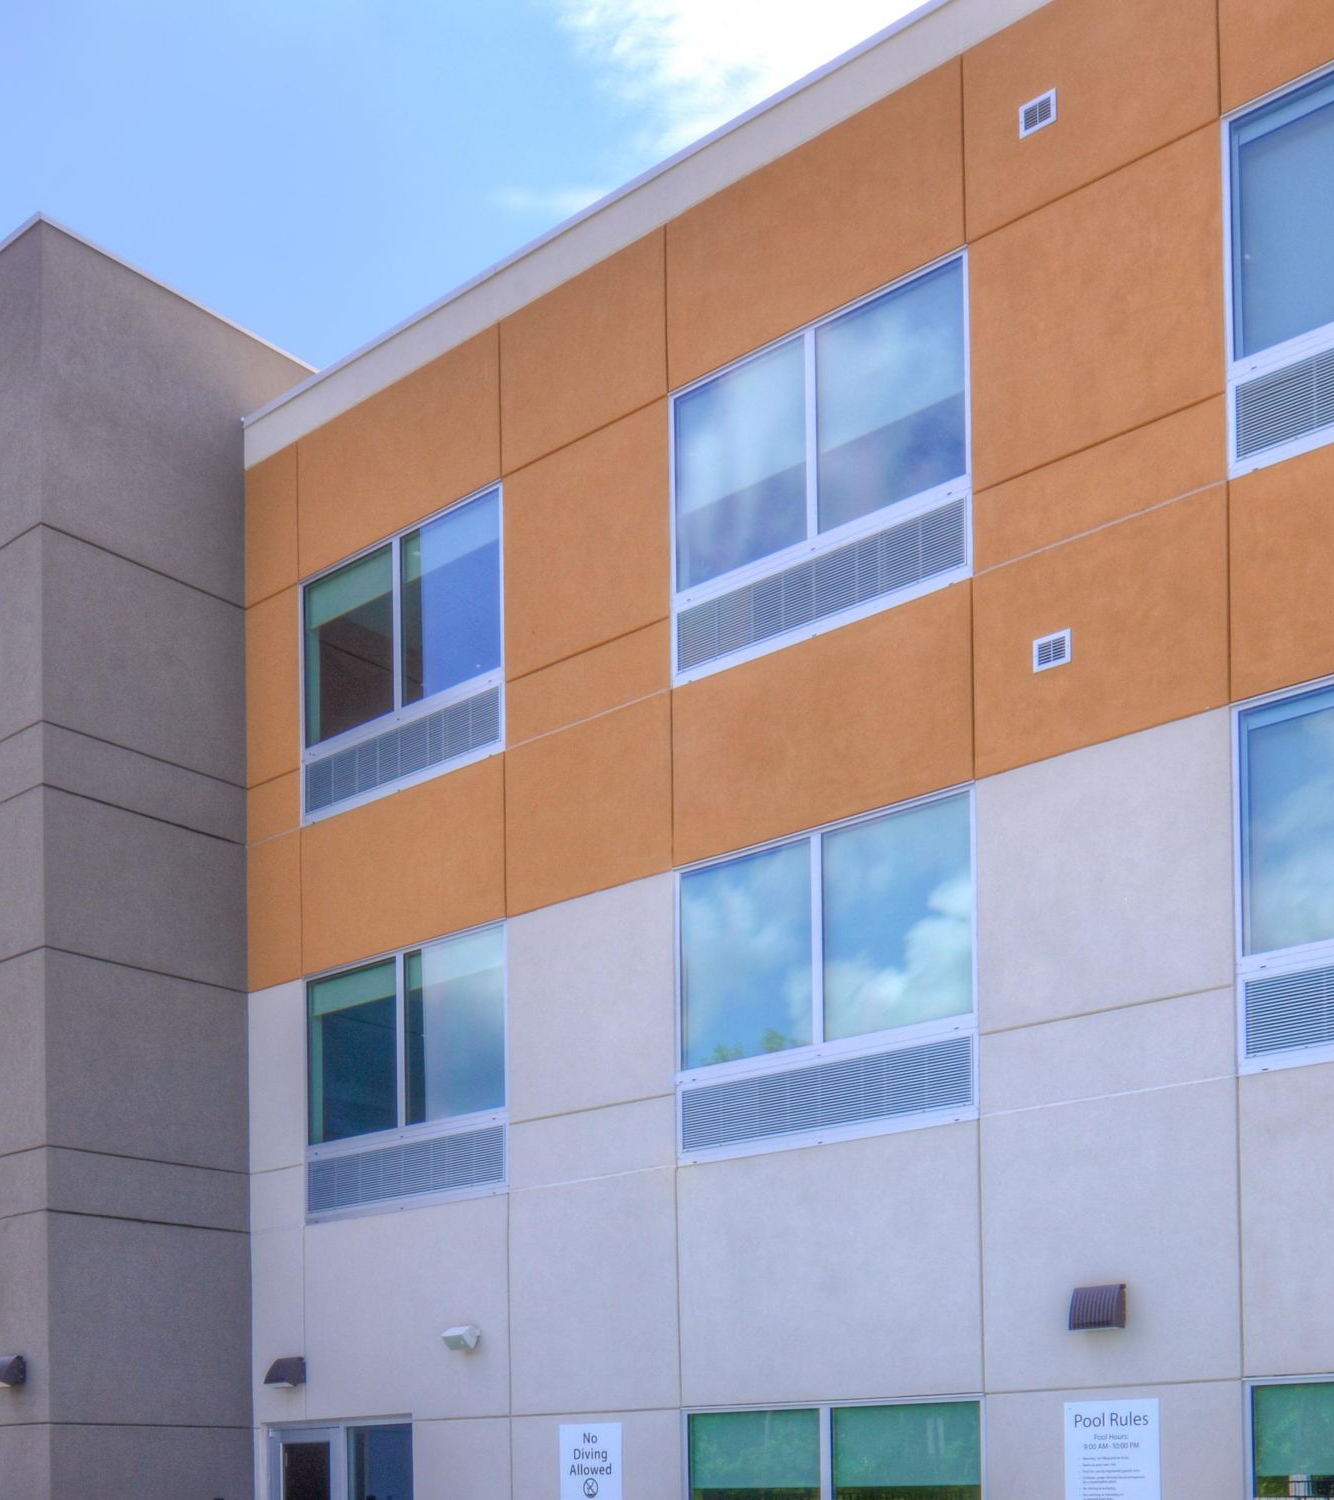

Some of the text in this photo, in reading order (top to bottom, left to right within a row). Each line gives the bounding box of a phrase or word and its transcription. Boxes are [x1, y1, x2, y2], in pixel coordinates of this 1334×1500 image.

[1073, 1411, 1149, 1428] Pool Rules
[582, 1432, 598, 1444] No
[1094, 1433, 1108, 1441] Pool
[1097, 1442, 1109, 1450] AM
[1129, 1441, 1140, 1449] PM
[573, 1447, 608, 1462] Diving
[569, 1463, 612, 1476] Allowed
